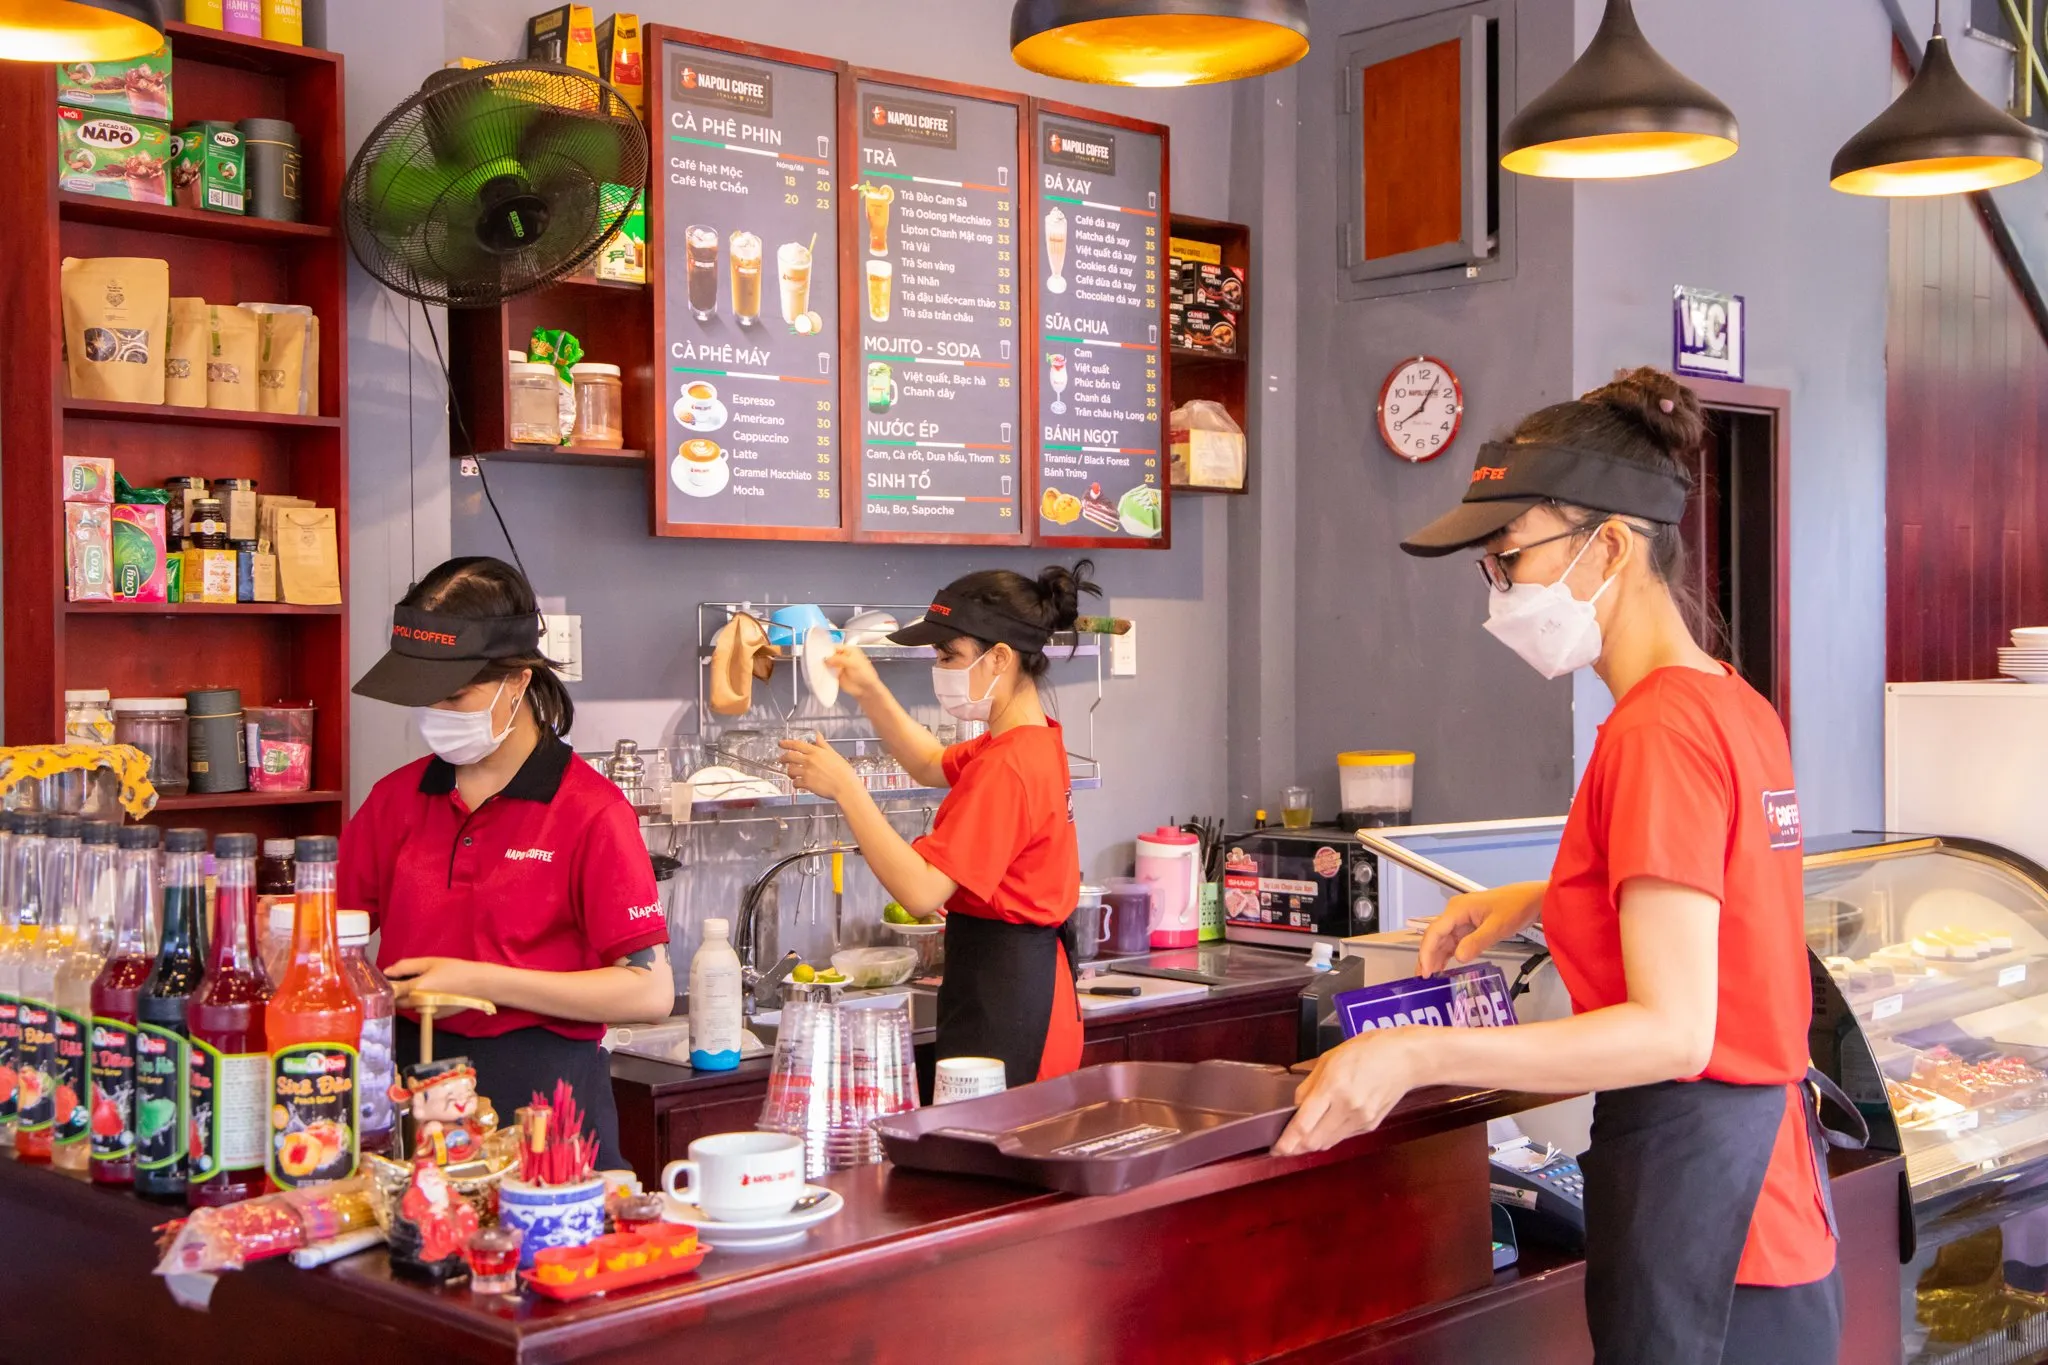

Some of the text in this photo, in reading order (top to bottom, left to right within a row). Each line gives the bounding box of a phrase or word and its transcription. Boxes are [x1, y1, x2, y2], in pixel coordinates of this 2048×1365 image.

[698, 73, 730, 92] NAPOLI
[732, 80, 763, 98] COFFEE
[98, 122, 119, 130] CACAO
[672, 110, 781, 146] CÀ PHÊ PHIN
[887, 110, 917, 127] NAPOLI
[919, 115, 948, 133] COFFEE
[82, 125, 133, 145] NAPO
[216, 135, 236, 145] NAPO
[1062, 138, 1109, 159] NAPOLI COFFEE
[863, 147, 897, 167] TRÀ
[671, 157, 830, 192] Café hạt Mộc 18 20
[671, 173, 829, 209] Café hạt Chồn 20 23
[1044, 172, 1092, 196] ĐÁ XAY
[901, 207, 1009, 228] Trà Oolong Macchiato 33
[1075, 215, 1094, 226] Café
[1107, 222, 1120, 232] xay
[1145, 226, 1155, 237] 35
[901, 224, 929, 236] Lipton
[931, 227, 957, 239] Chanh
[977, 234, 993, 244] ong
[998, 234, 1010, 245] 33
[1075, 230, 1103, 243] Matcha
[1117, 237, 1130, 248] xay
[1145, 241, 1155, 251] 35
[901, 257, 915, 268] Trà
[917, 260, 933, 269] Sen
[998, 268, 1010, 278] 33
[1075, 259, 1106, 272] Cookies
[1120, 267, 1133, 277] xay
[1145, 270, 1155, 280] 35
[1075, 290, 1115, 303] Chocolate
[1128, 298, 1141, 307] xay
[1146, 299, 1156, 308] 35
[1045, 312, 1109, 335] SỮA CHUA
[1681, 298, 1727, 352] WC
[671, 340, 770, 366] CÀ PHÊ MÁY
[864, 335, 922, 354] MOJITO
[937, 342, 982, 358] SODA
[1074, 348, 1156, 364] Cam 35
[903, 371, 924, 383] Việt
[954, 374, 971, 387] Bạc
[974, 375, 986, 386] hà
[998, 378, 1010, 387] 35
[1146, 369, 1156, 379] 35
[1407, 375, 1415, 384] 11
[1418, 369, 1431, 380] 12
[903, 387, 955, 400] Chanh dây
[1074, 392, 1099, 403] Chanh
[1146, 398, 1156, 407] 35
[1395, 388, 1406, 398] 10
[1443, 388, 1453, 398] 2
[733, 394, 831, 411] Espresso 30
[1390, 404, 1400, 414] 9
[1445, 404, 1455, 414] 3
[733, 413, 831, 428] Americano 30
[867, 418, 939, 437] NƯỚC ÉP
[1393, 420, 1402, 431] 8
[1440, 421, 1450, 431] 4
[733, 431, 830, 446] Cappuccino 35
[1045, 423, 1118, 447] BÁNH NGỌT
[1403, 434, 1411, 444] 7
[1431, 434, 1440, 445] 5
[1415, 439, 1425, 449] 6
[733, 448, 830, 464] Latte 35
[867, 450, 891, 461] Cam,
[893, 450, 905, 460] Cà
[999, 454, 1011, 464] 35
[1044, 454, 1077, 464] Tiramisu
[1084, 455, 1105, 465] Black
[1106, 456, 1130, 467] Forest
[1144, 458, 1155, 468] 40
[73, 468, 83, 490] Cozy
[733, 467, 830, 481] Caramel Macchiato 35
[867, 469, 931, 489] SINH TỐ
[1045, 467, 1064, 477] Bánh
[1145, 474, 1154, 483] 22
[733, 485, 830, 498] Mocha 35
[867, 504, 1012, 520] Dâu, Bơ, Sapoche 35
[88, 550, 100, 579] Cozy
[124, 568, 136, 594] Cozy
[413, 629, 457, 646] COFFEE
[1228, 878, 1256, 886] SHARP
